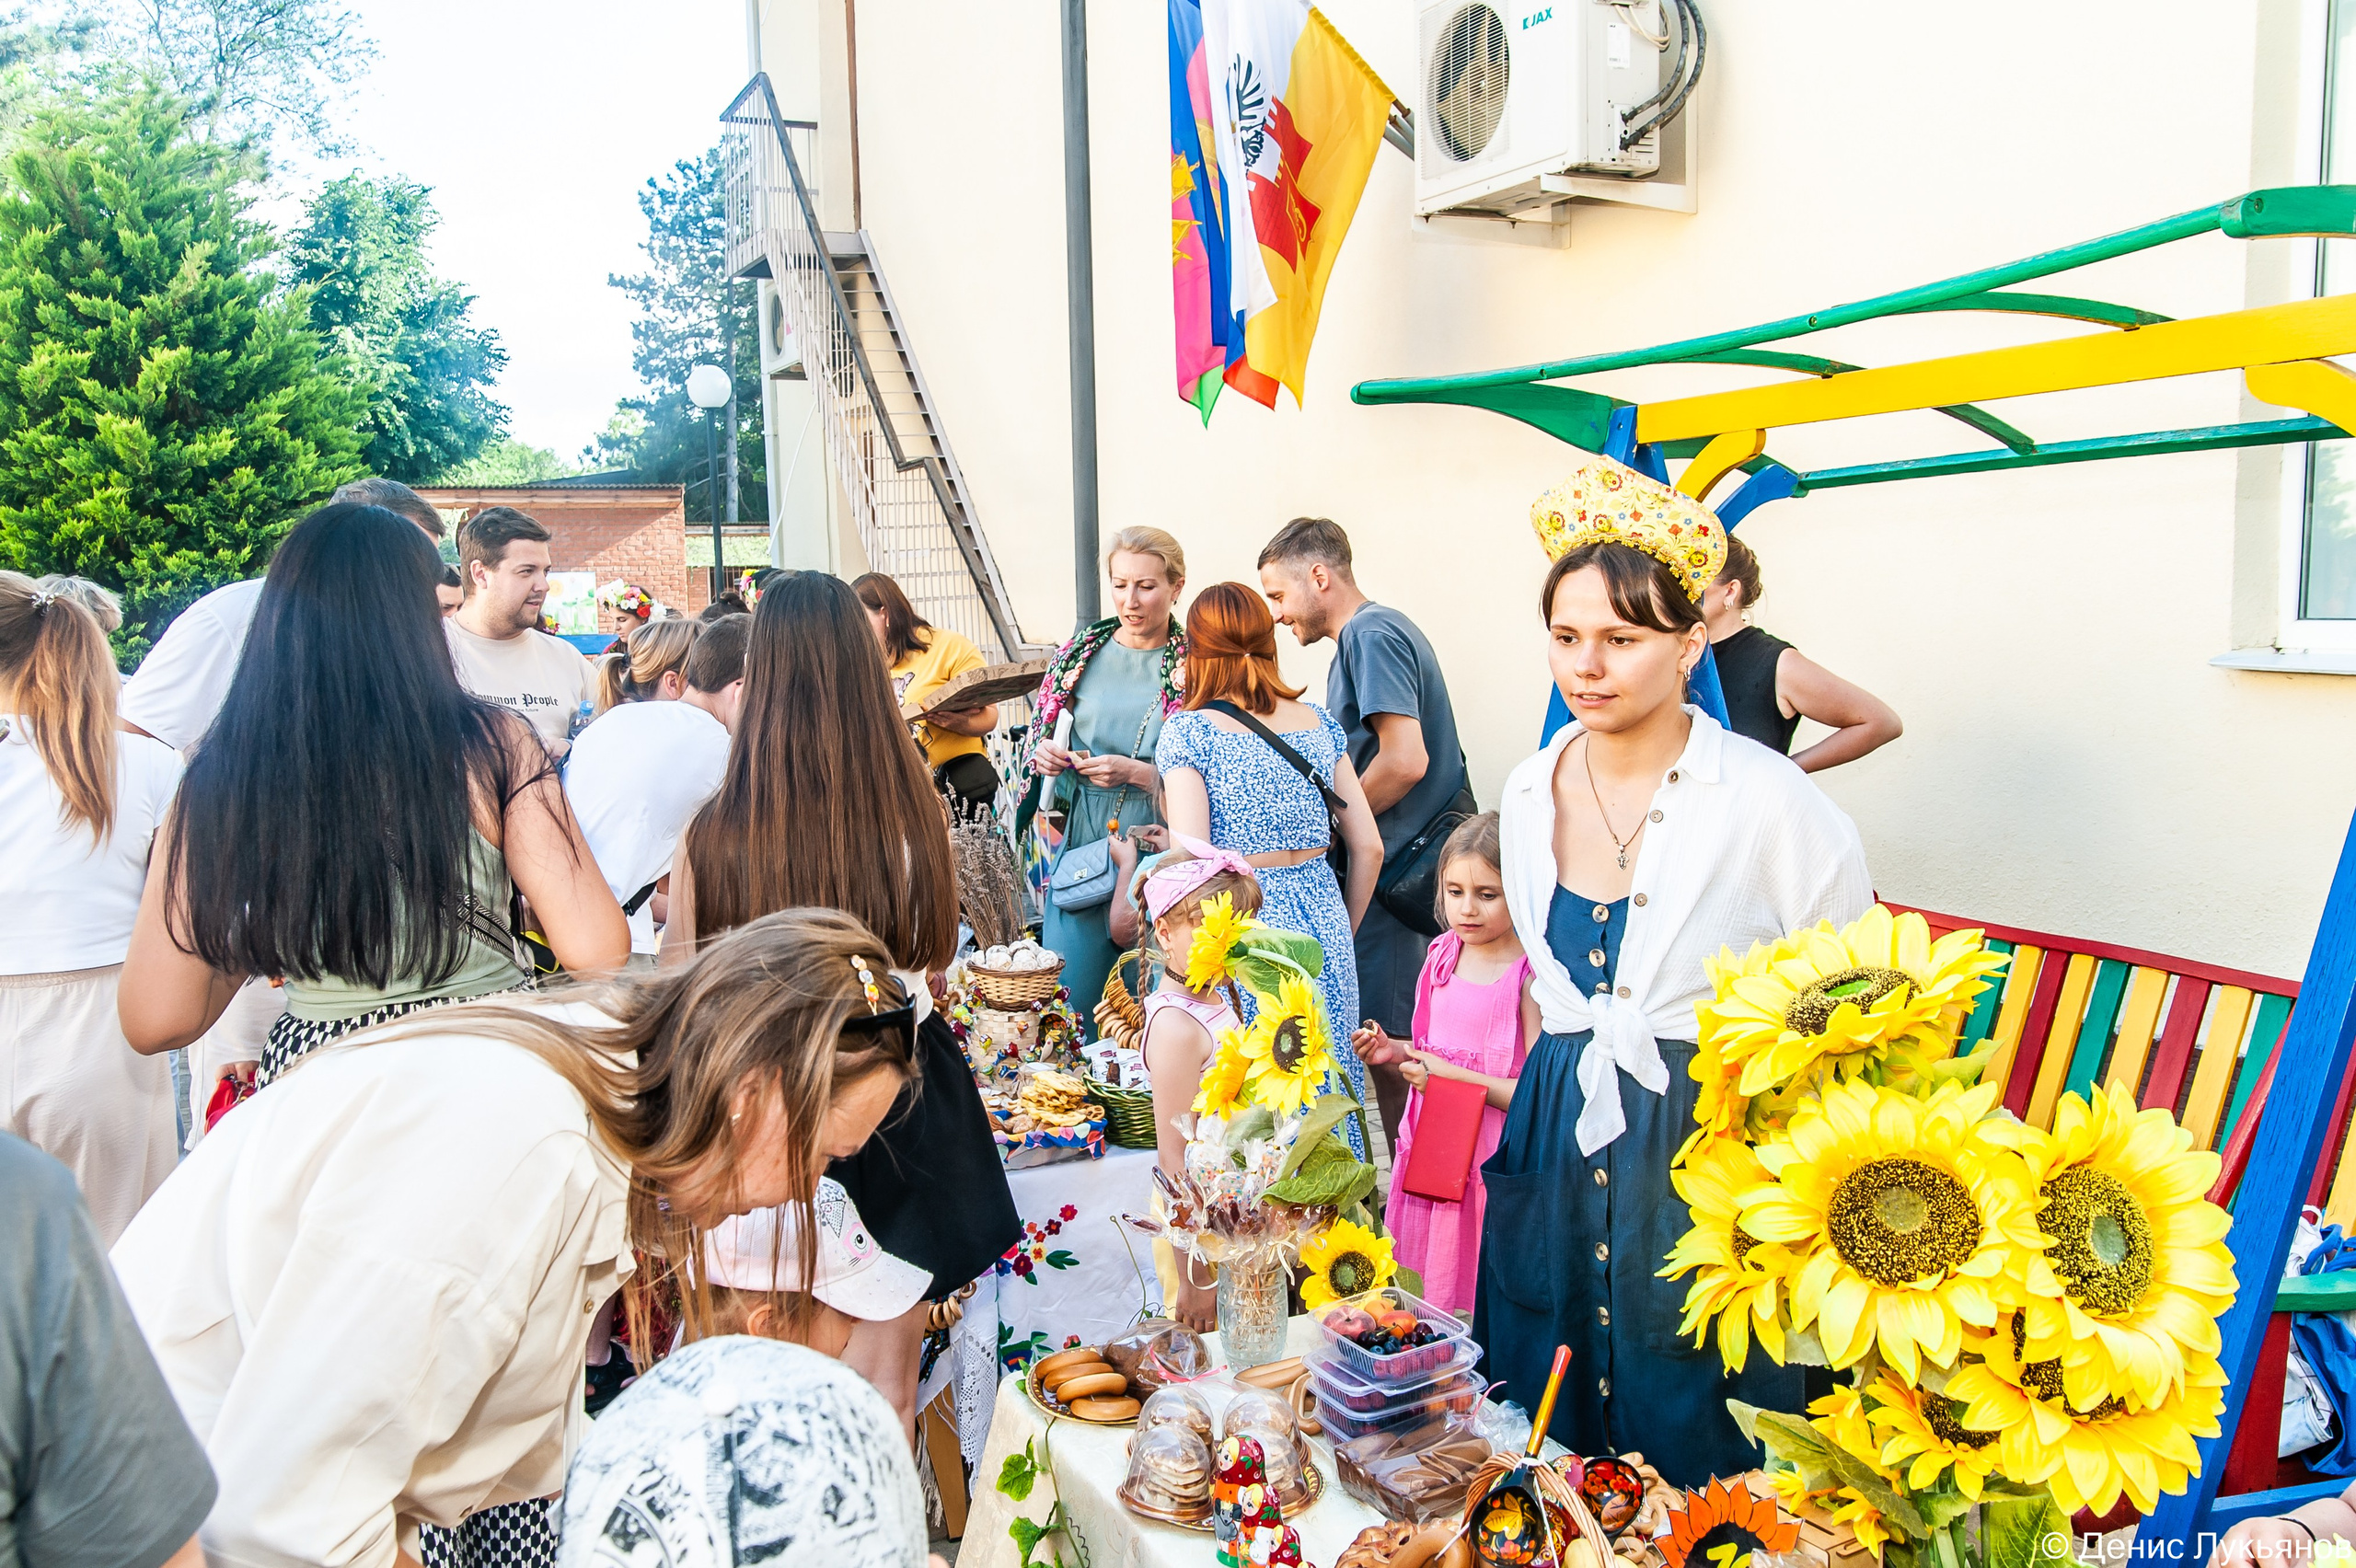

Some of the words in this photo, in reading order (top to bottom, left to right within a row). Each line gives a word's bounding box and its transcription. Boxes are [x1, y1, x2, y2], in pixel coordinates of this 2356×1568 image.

[1531, 6, 1553, 27] JAX
[477, 694, 517, 706] ommon
[522, 693, 559, 707] People
